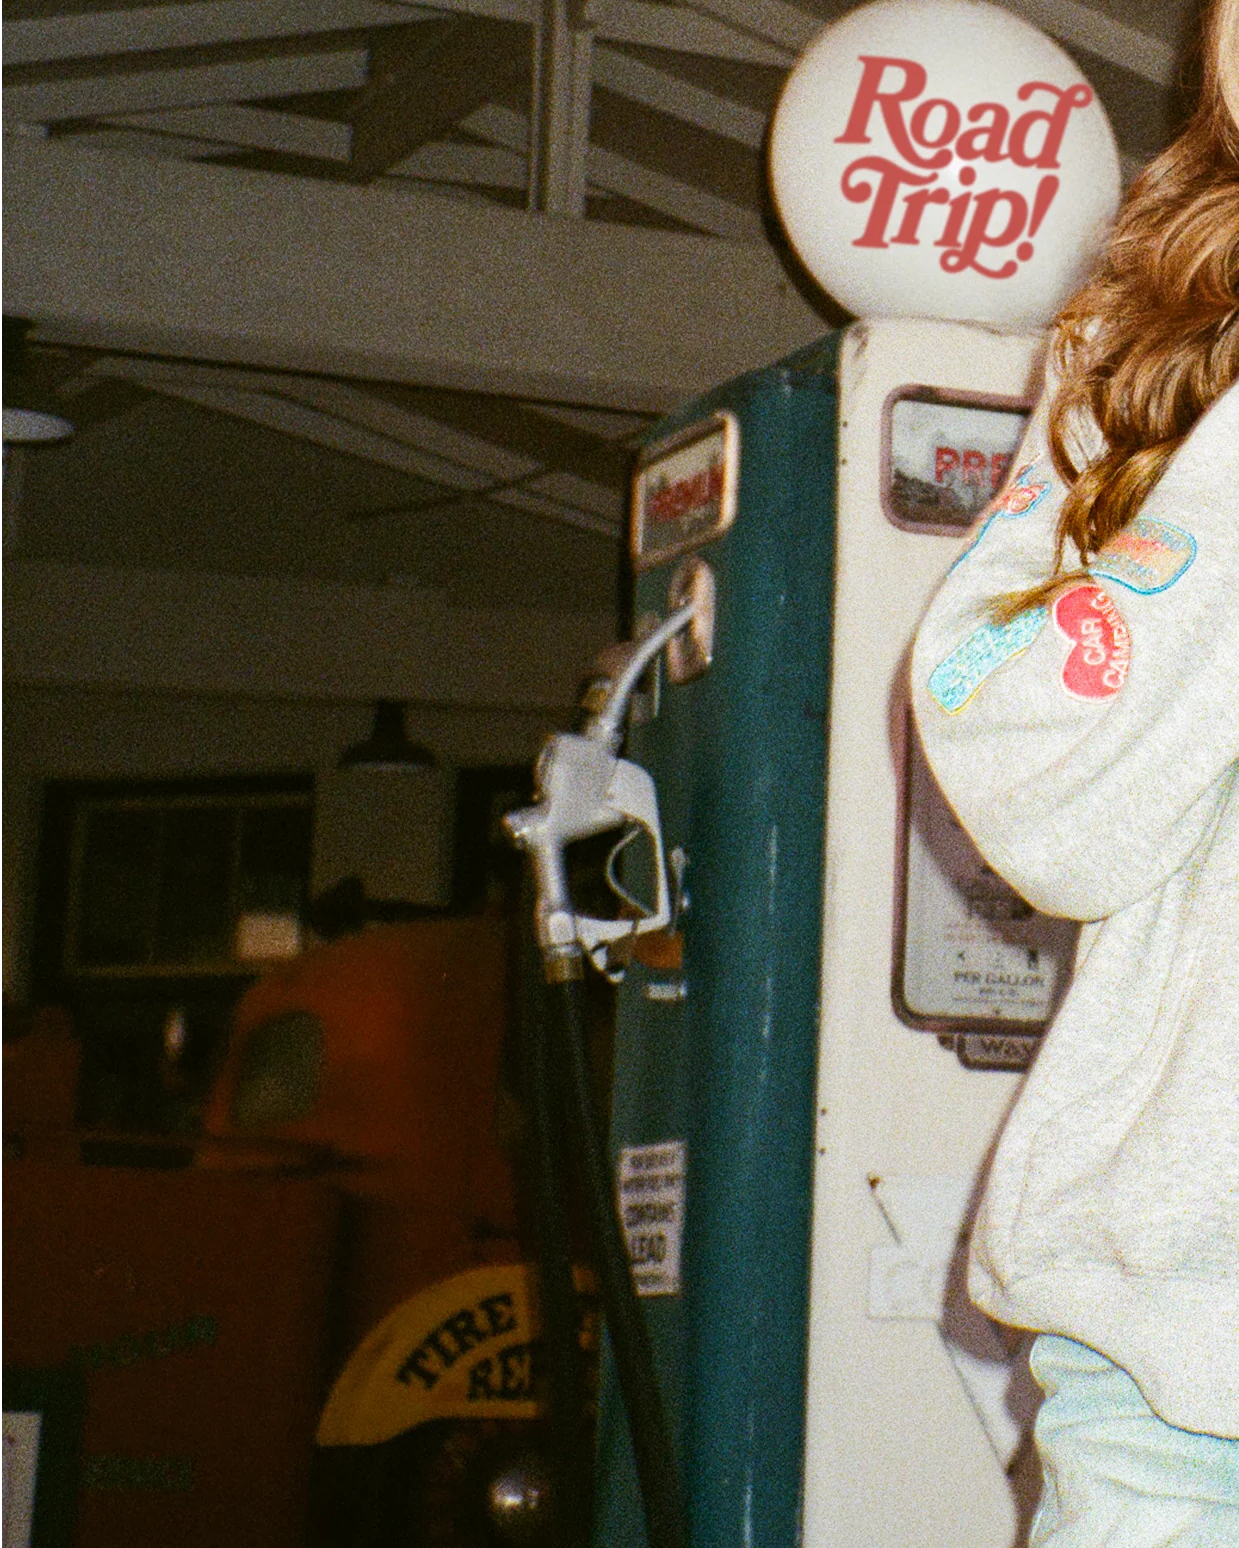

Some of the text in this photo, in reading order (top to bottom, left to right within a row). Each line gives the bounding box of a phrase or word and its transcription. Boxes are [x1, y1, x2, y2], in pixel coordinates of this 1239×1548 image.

[834, 55, 1093, 170] Road
[840, 155, 1060, 279] Trip!
[1081, 617, 1105, 665] CAR
[395, 1292, 518, 1391] TIRE
